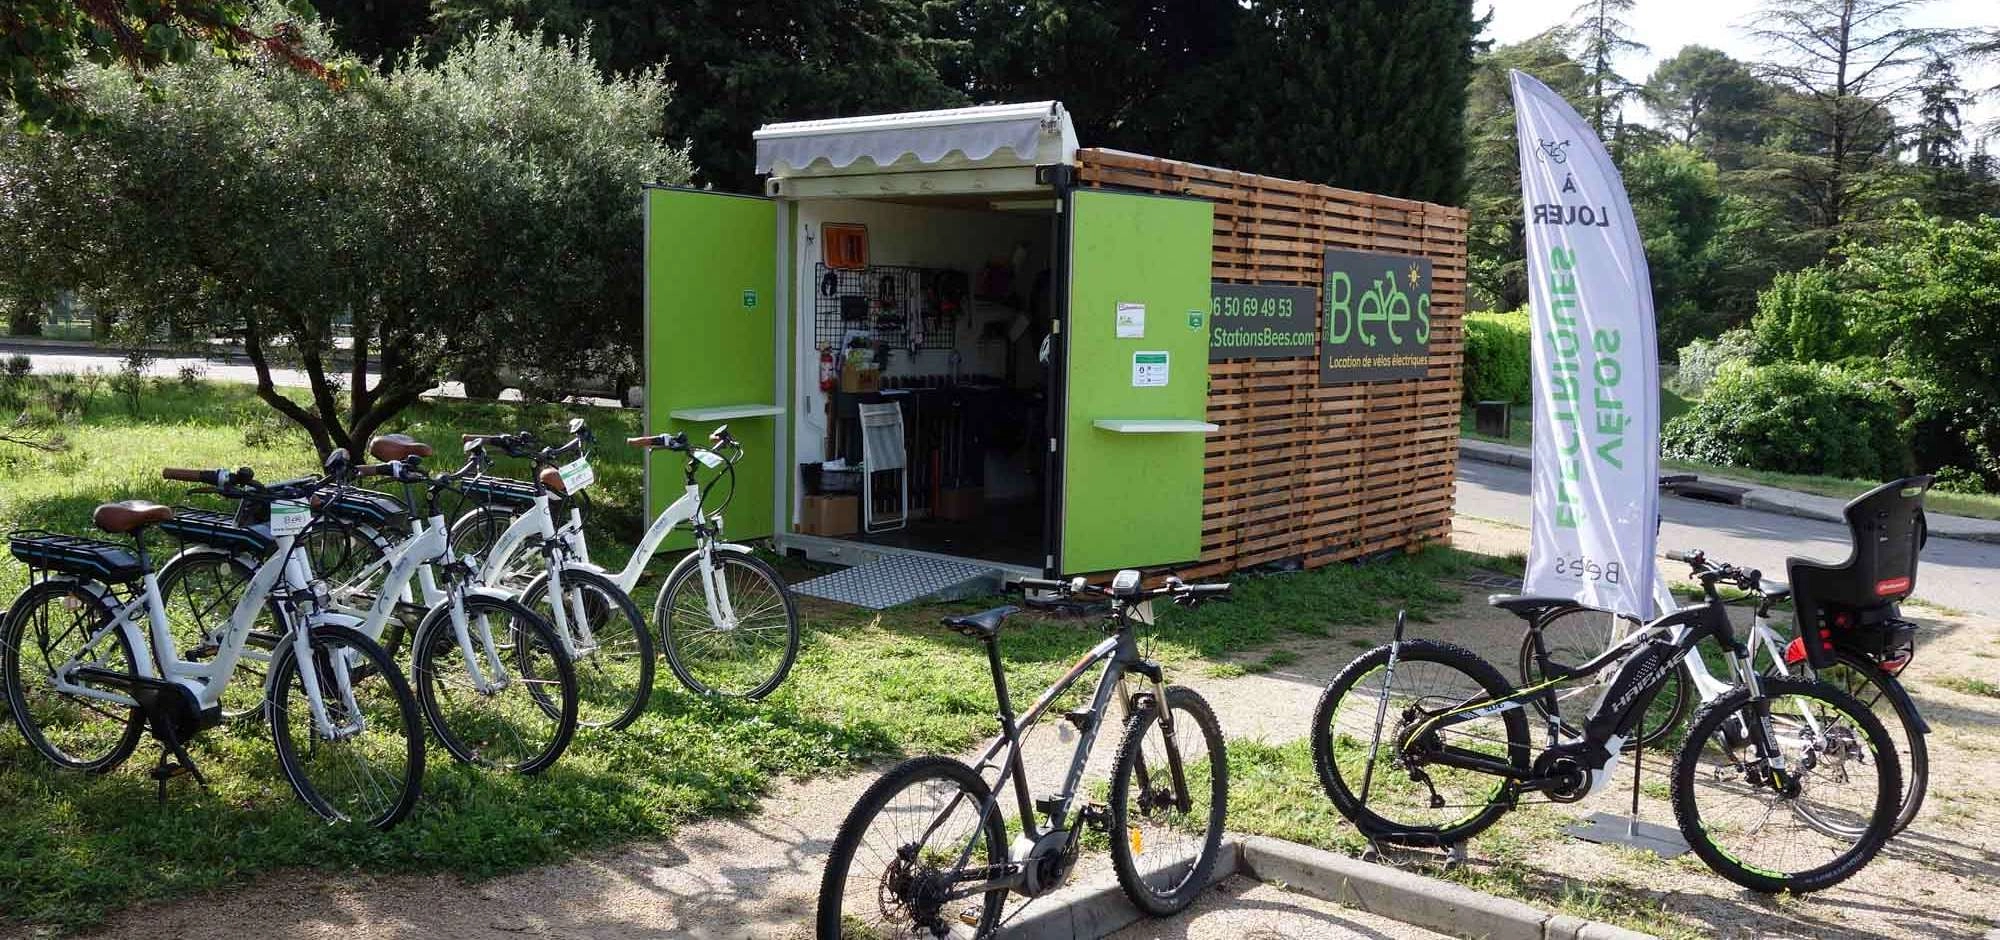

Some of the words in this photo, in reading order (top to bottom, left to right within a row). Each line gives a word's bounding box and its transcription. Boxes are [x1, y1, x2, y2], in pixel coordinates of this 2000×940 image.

[1224, 296, 1240, 317] 50
[1243, 296, 1258, 317] 69
[1261, 297, 1276, 317] 49
[1279, 298, 1293, 317] 53
[1329, 270, 1430, 346] Bees
[1329, 355, 1361, 368] Location
[1362, 353, 1373, 367] de
[1612, 647, 1687, 712] HAIBIKE
